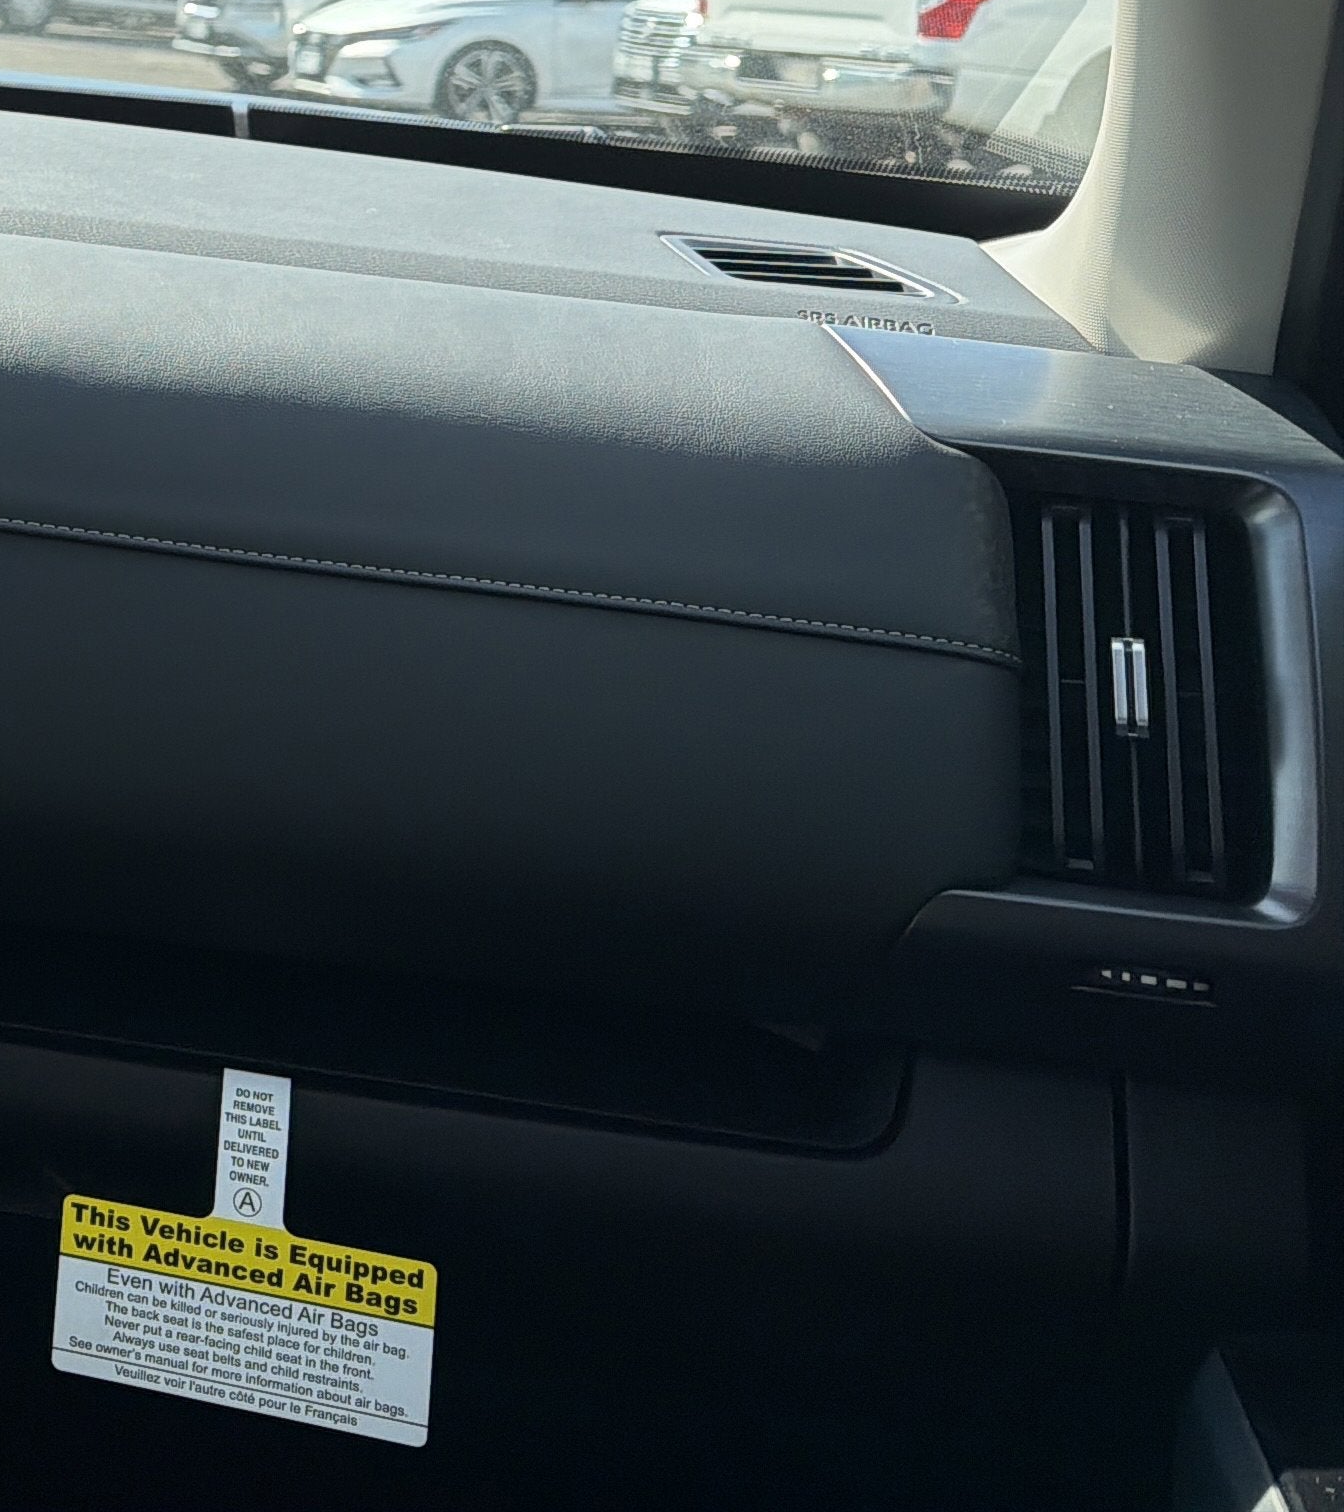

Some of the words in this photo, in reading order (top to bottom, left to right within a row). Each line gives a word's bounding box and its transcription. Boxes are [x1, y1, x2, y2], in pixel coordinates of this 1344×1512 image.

[797, 310, 838, 325] SRS
[844, 314, 934, 336] AIRBAG
[224, 1111, 246, 1124] THIS
[249, 1116, 281, 1131] LABEL
[232, 1099, 275, 1116] REMOVE
[235, 1087, 250, 1098] DO
[252, 1090, 273, 1102] NOT
[223, 1139, 279, 1159] DELIVERED
[230, 1155, 244, 1167] TO
[246, 1158, 269, 1171] NEW
[237, 1127, 266, 1142] UNTIL
[229, 1170, 268, 1186] OWNER.
[70, 1201, 130, 1231] This
[140, 1214, 244, 1253] Vehicle
[254, 1237, 278, 1260] is
[289, 1243, 424, 1289] Equipped
[72, 1233, 132, 1258] with
[142, 1243, 283, 1288] Advanced
[292, 1272, 336, 1297] Air
[345, 1281, 417, 1315] Bags
[74, 1280, 123, 1300] Children
[126, 1292, 148, 1305] can
[151, 1295, 167, 1308] be
[170, 1299, 201, 1315] killed
[204, 1308, 217, 1318] or
[220, 1311, 274, 1332] seriously
[277, 1320, 318, 1339] injured
[322, 1329, 337, 1345] by
[340, 1333, 360, 1347] the
[362, 1339, 379, 1351] air
[382, 1342, 410, 1360] bag.
[105, 1300, 128, 1315] The
[131, 1305, 159, 1321] back
[162, 1314, 188, 1327] seat
[191, 1317, 201, 1330] is
[204, 1321, 224, 1334] the
[227, 1327, 264, 1343] safest
[266, 1334, 300, 1350] place
[303, 1340, 320, 1354] for
[323, 1345, 375, 1365] children.
[107, 1267, 152, 1291] Even
[158, 1280, 194, 1300] with
[199, 1286, 292, 1319] Advanced
[297, 1306, 324, 1325] Air
[330, 1311, 378, 1338] Bags
[68, 1335, 92, 1350] See
[95, 1343, 141, 1360] owner's
[144, 1353, 188, 1370] manual
[191, 1360, 208, 1374] for
[211, 1367, 242, 1381] more
[245, 1372, 313, 1397] information
[316, 1388, 351, 1405] about
[354, 1397, 371, 1409] air
[374, 1399, 407, 1417] bags.
[104, 1314, 140, 1331] Never
[142, 1324, 162, 1336] put
[164, 1329, 172, 1338] a
[175, 1331, 240, 1355] rear-facing
[243, 1344, 272, 1359] child
[275, 1352, 302, 1365] seat
[305, 1355, 316, 1368] in
[319, 1358, 339, 1372] the
[342, 1363, 373, 1379] front.
[112, 1330, 155, 1349] Always
[158, 1341, 180, 1354] use
[183, 1347, 209, 1361] seat
[212, 1350, 241, 1367] belts
[244, 1360, 267, 1372] and
[270, 1364, 299, 1379] child
[302, 1371, 362, 1392] restraints.
[114, 1363, 160, 1384] Veuillez
[163, 1376, 186, 1389] voir
[188, 1379, 225, 1398] l'autre
[228, 1390, 255, 1404] côté
[258, 1397, 287, 1410] pour
[289, 1401, 301, 1414] le
[304, 1404, 357, 1426] Français
